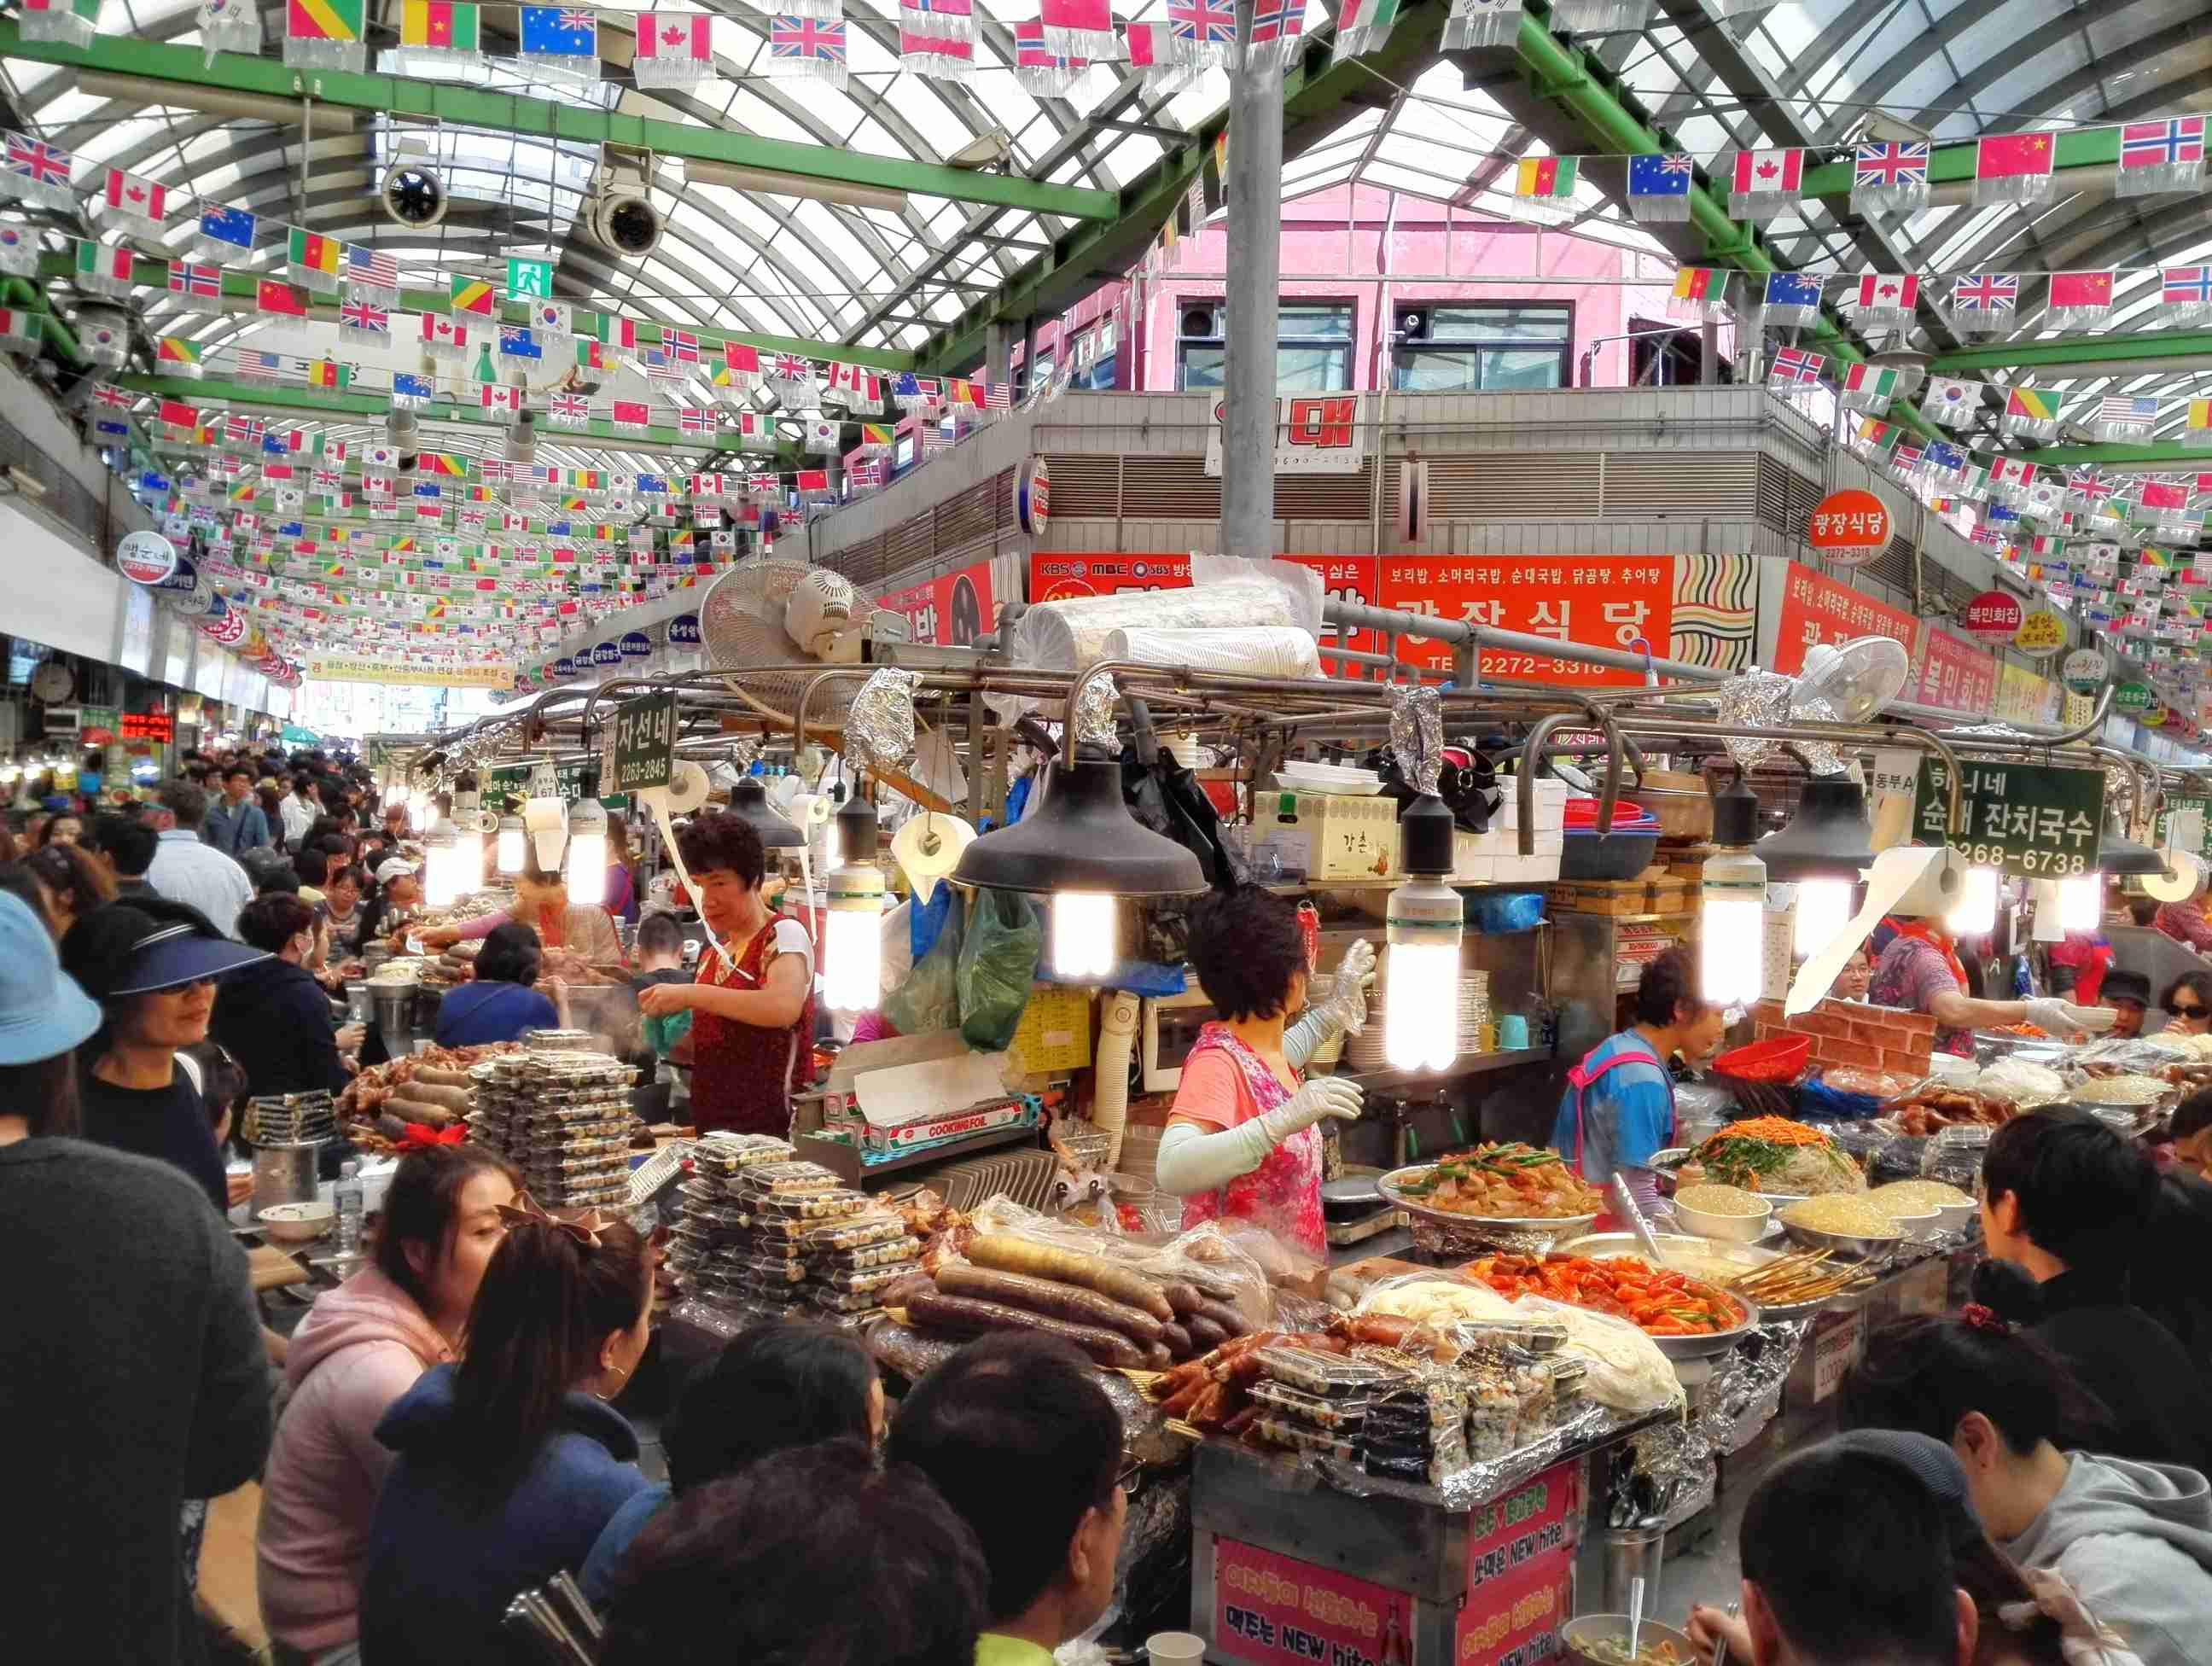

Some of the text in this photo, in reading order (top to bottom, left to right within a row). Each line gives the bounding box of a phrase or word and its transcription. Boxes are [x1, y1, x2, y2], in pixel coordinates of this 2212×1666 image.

[1813, 511, 1884, 536] 광장식당
[1825, 547, 1871, 559] 2272-3318
[1040, 563, 1069, 575] KBS
[1092, 563, 1128, 575] MBC
[1150, 564, 1169, 575] SBS
[1329, 563, 1359, 580] 싶은
[1621, 568, 1661, 584] 추어탕
[1481, 656, 1605, 674] 2272-3318
[618, 706, 671, 752] 자선네
[621, 758, 667, 783] 2263-2845
[1984, 801, 2095, 848] 잔치국수
[928, 1116, 988, 1138] COOKING FOIL
[1511, 1533, 1536, 1565] NEW
[1540, 1523, 1563, 1551] hite
[1282, 1624, 1325, 1661] NEW
[1528, 1632, 1552, 1663] hite
